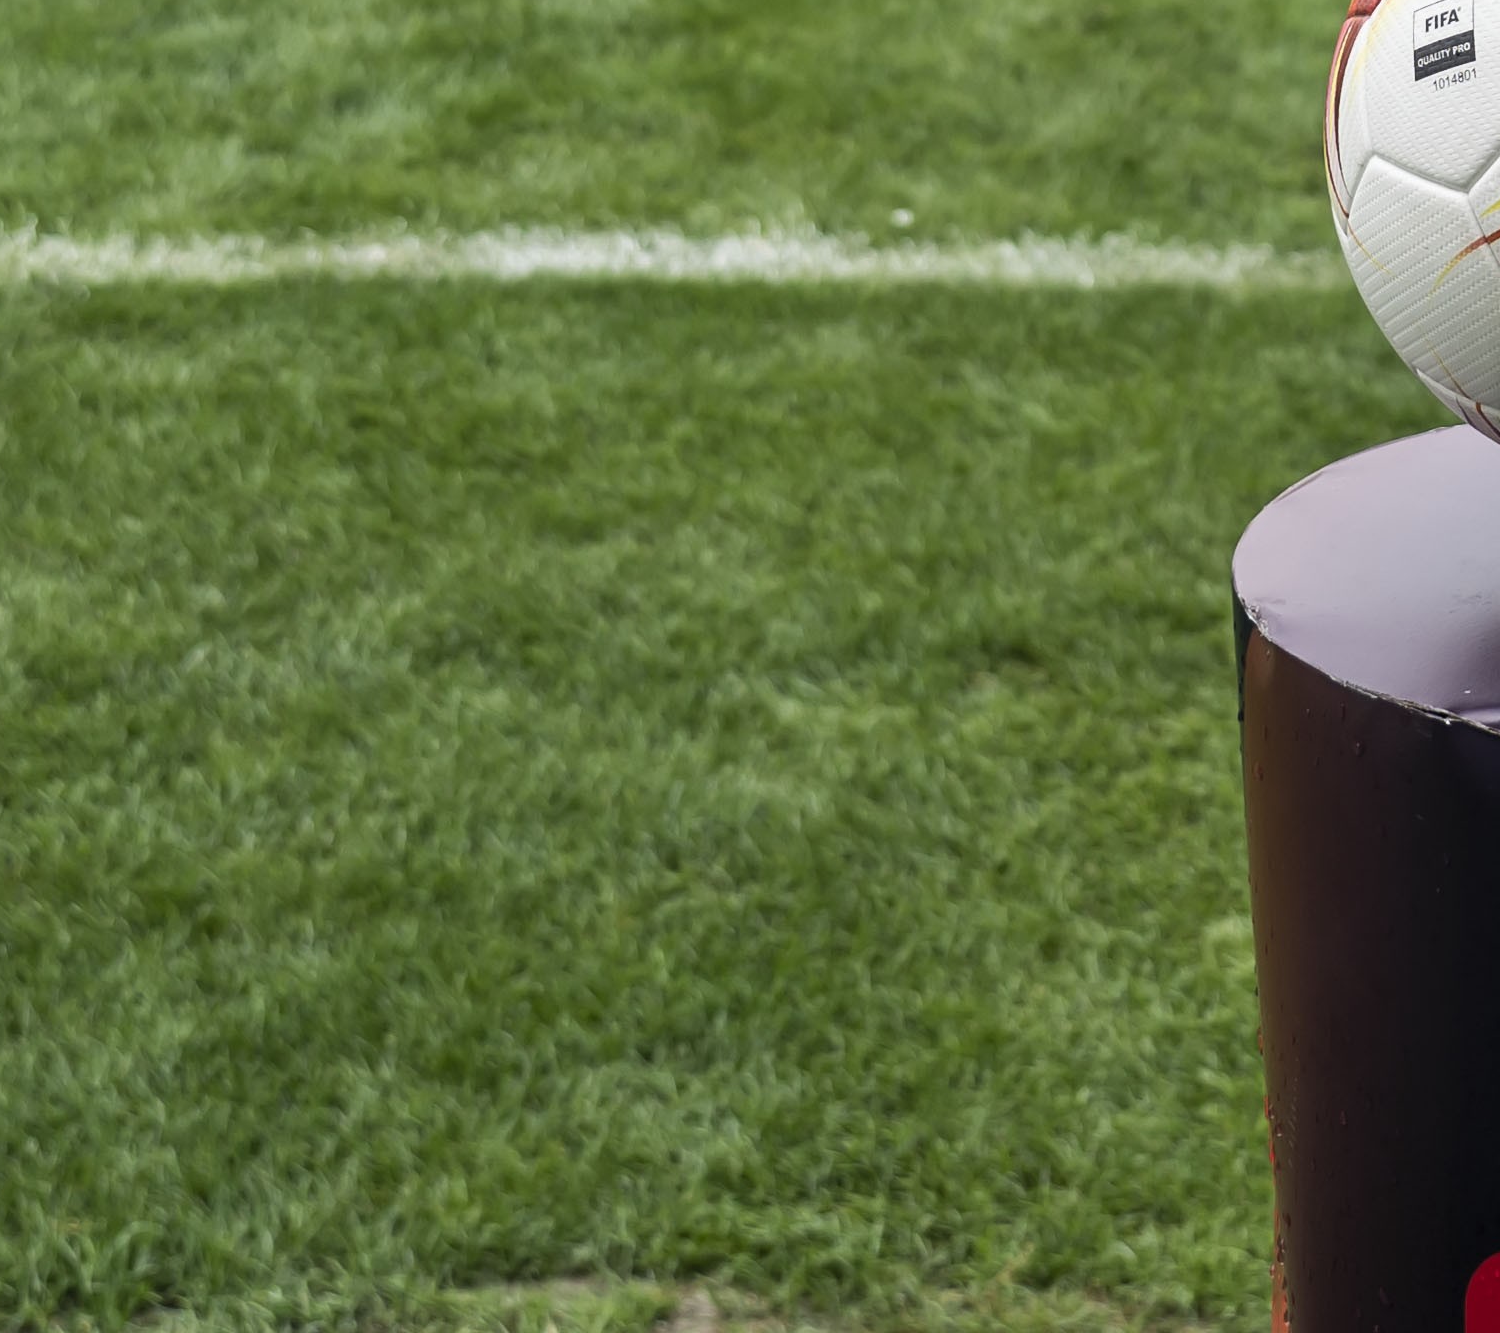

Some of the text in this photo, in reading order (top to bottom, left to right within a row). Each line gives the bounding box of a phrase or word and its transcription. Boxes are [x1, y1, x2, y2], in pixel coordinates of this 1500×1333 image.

[1425, 8, 1460, 33] FIFA
[1417, 42, 1471, 68] QUALITY PRO
[1433, 68, 1477, 91] 1014801
